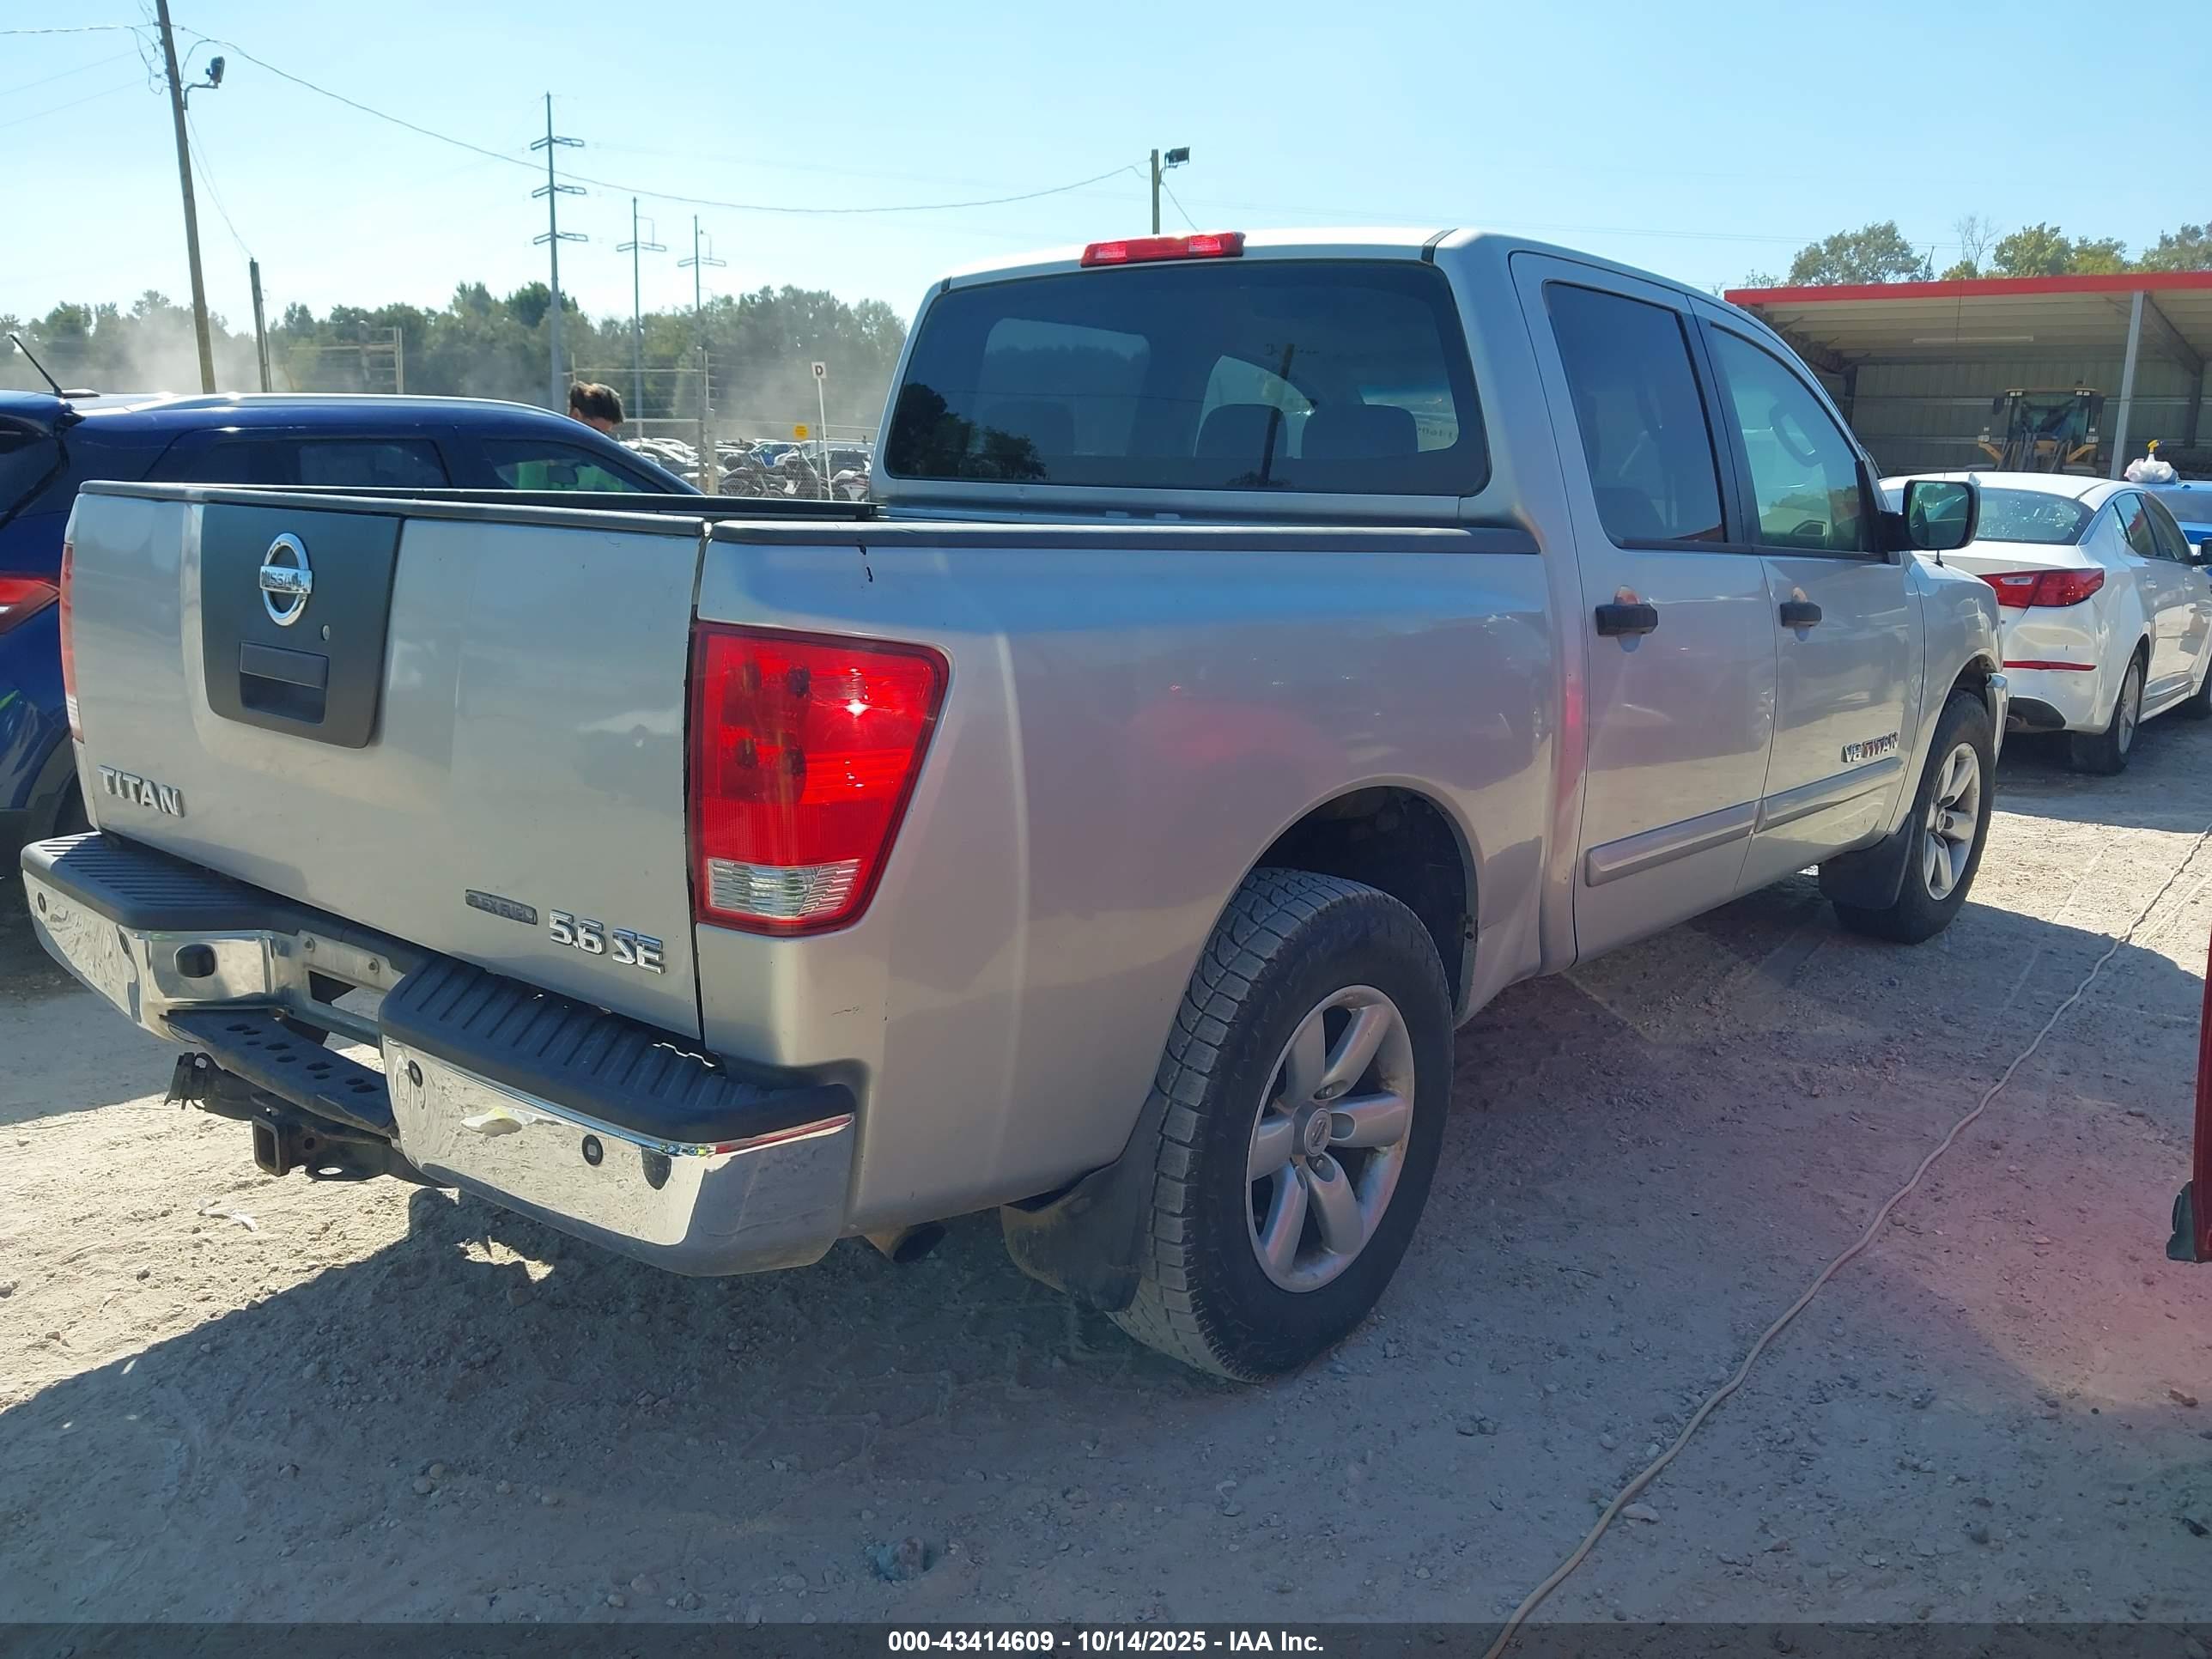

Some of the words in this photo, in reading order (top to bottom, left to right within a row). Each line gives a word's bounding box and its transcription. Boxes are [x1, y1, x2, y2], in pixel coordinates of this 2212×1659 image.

[815, 365, 823, 376] D
[260, 569, 304, 588] NISSAN
[96, 763, 184, 817] TITAN
[549, 908, 605, 955] 5.6
[612, 928, 665, 975] SE
